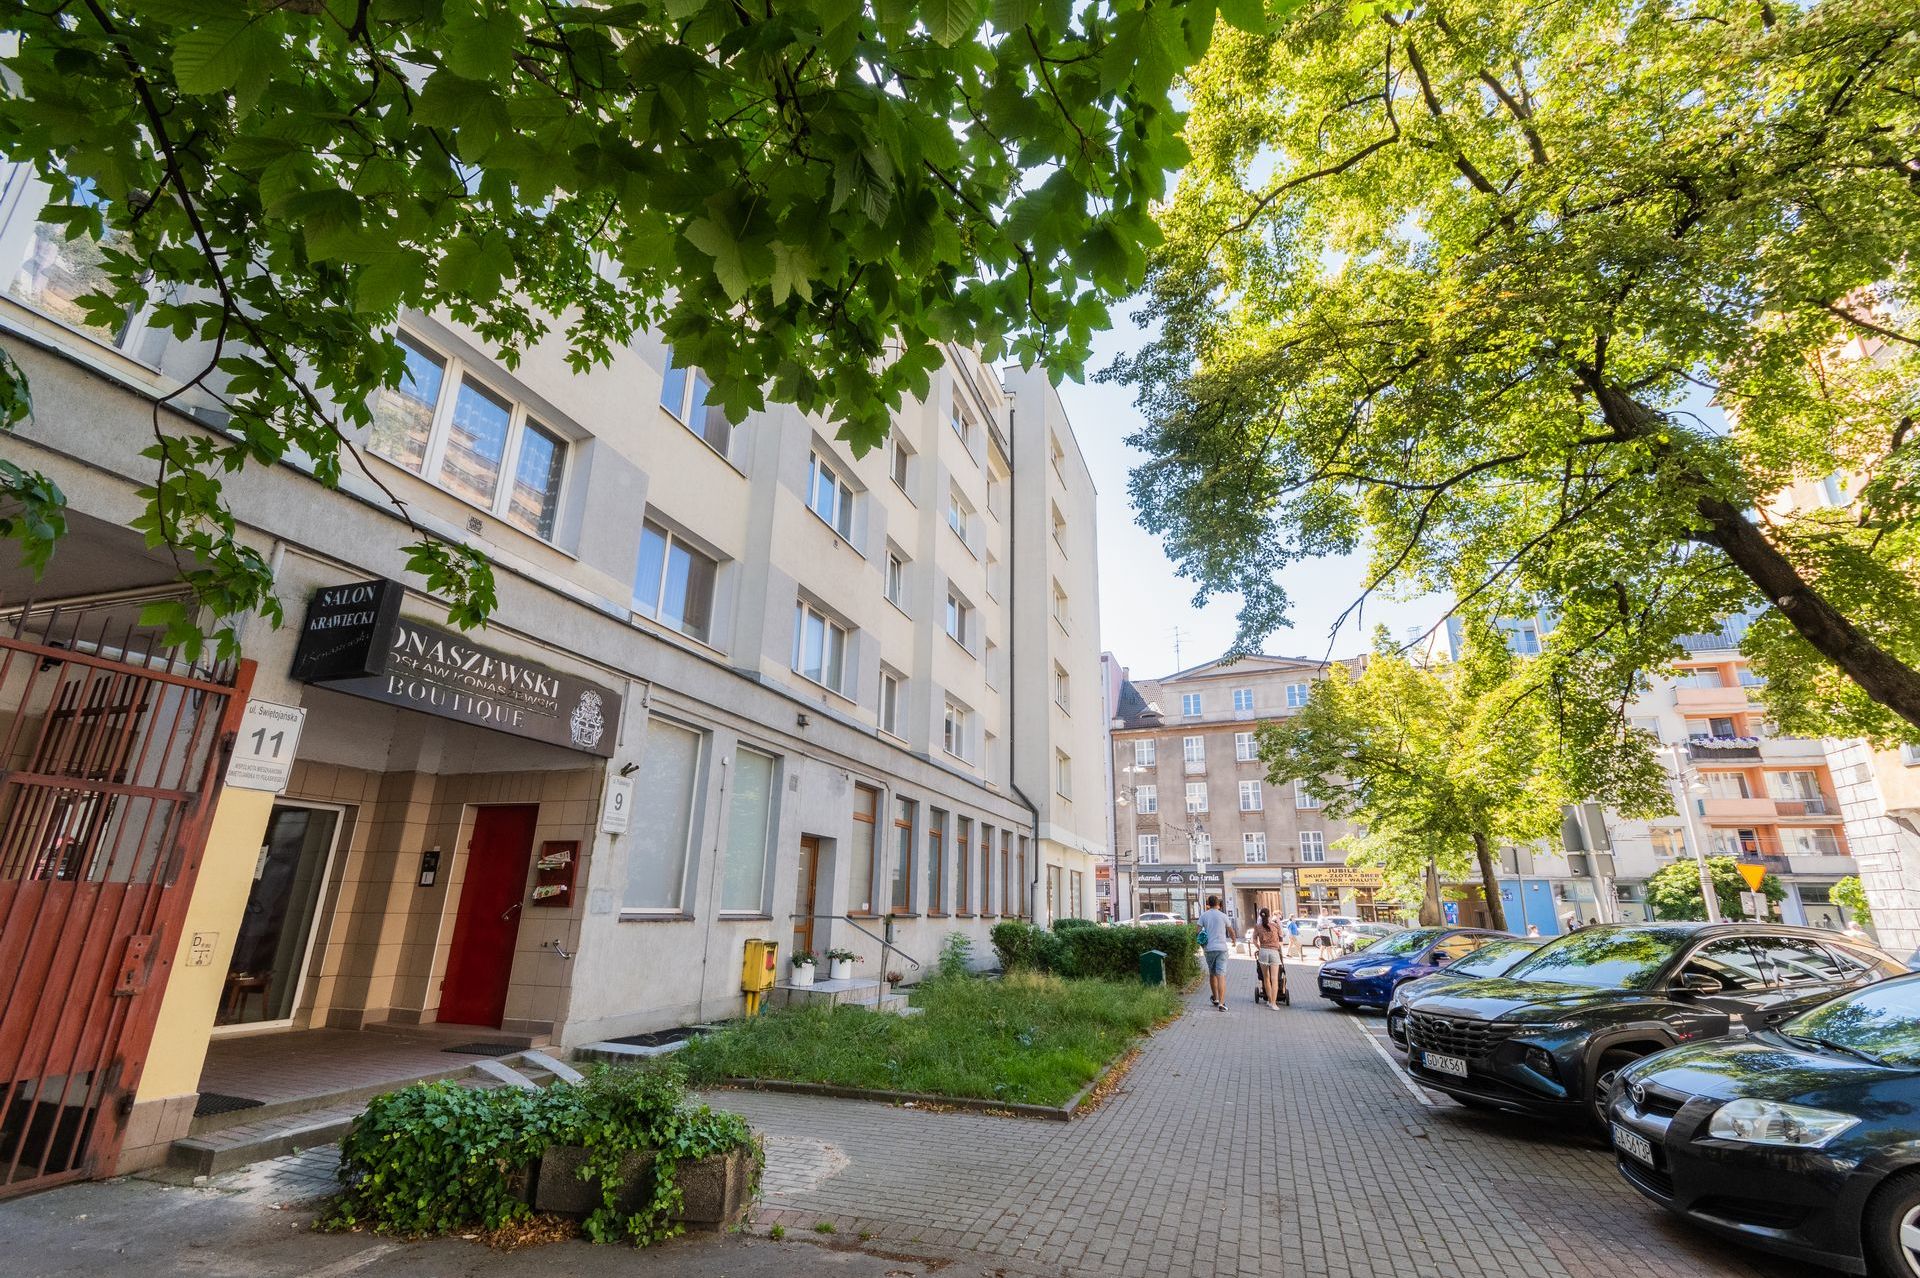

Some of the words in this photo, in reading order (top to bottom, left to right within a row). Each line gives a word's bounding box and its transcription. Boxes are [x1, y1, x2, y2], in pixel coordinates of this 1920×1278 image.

[321, 585, 377, 607] SALON
[310, 611, 375, 631] KRAWIECKI
[387, 675, 525, 728] BOUTIQUE
[452, 671, 558, 712] KONASZEWSKI
[258, 705, 298, 722] Świętojańska
[251, 727, 284, 758] 11
[614, 792, 623, 811] 9
[1615, 1127, 1627, 1148] GA
